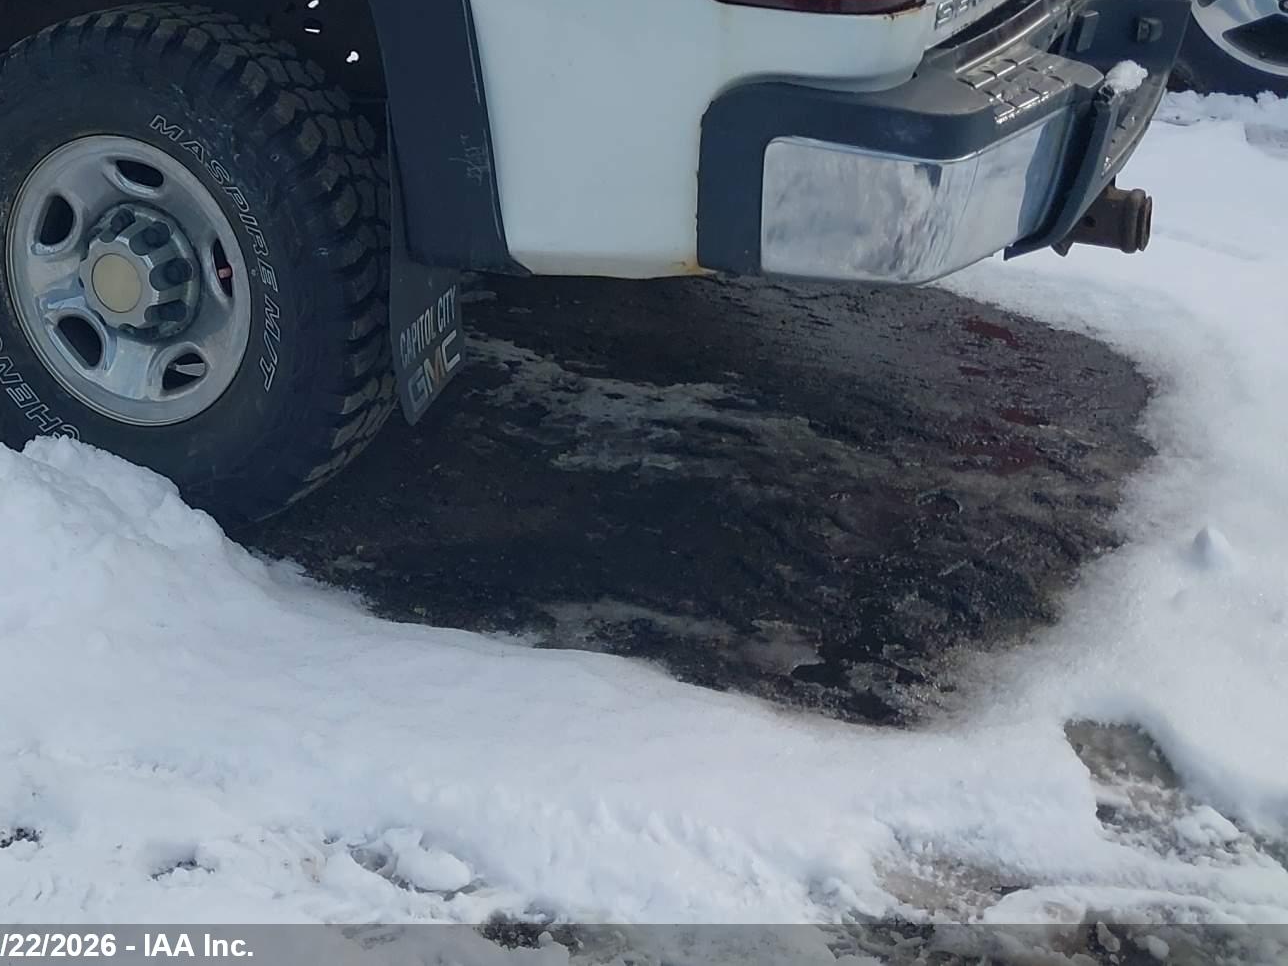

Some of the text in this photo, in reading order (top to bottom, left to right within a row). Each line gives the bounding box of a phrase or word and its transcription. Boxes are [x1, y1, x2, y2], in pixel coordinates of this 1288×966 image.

[149, 114, 282, 393] MASPIRE M/T
[399, 284, 456, 370] CAPITOL CITY
[407, 329, 461, 413] GMC
